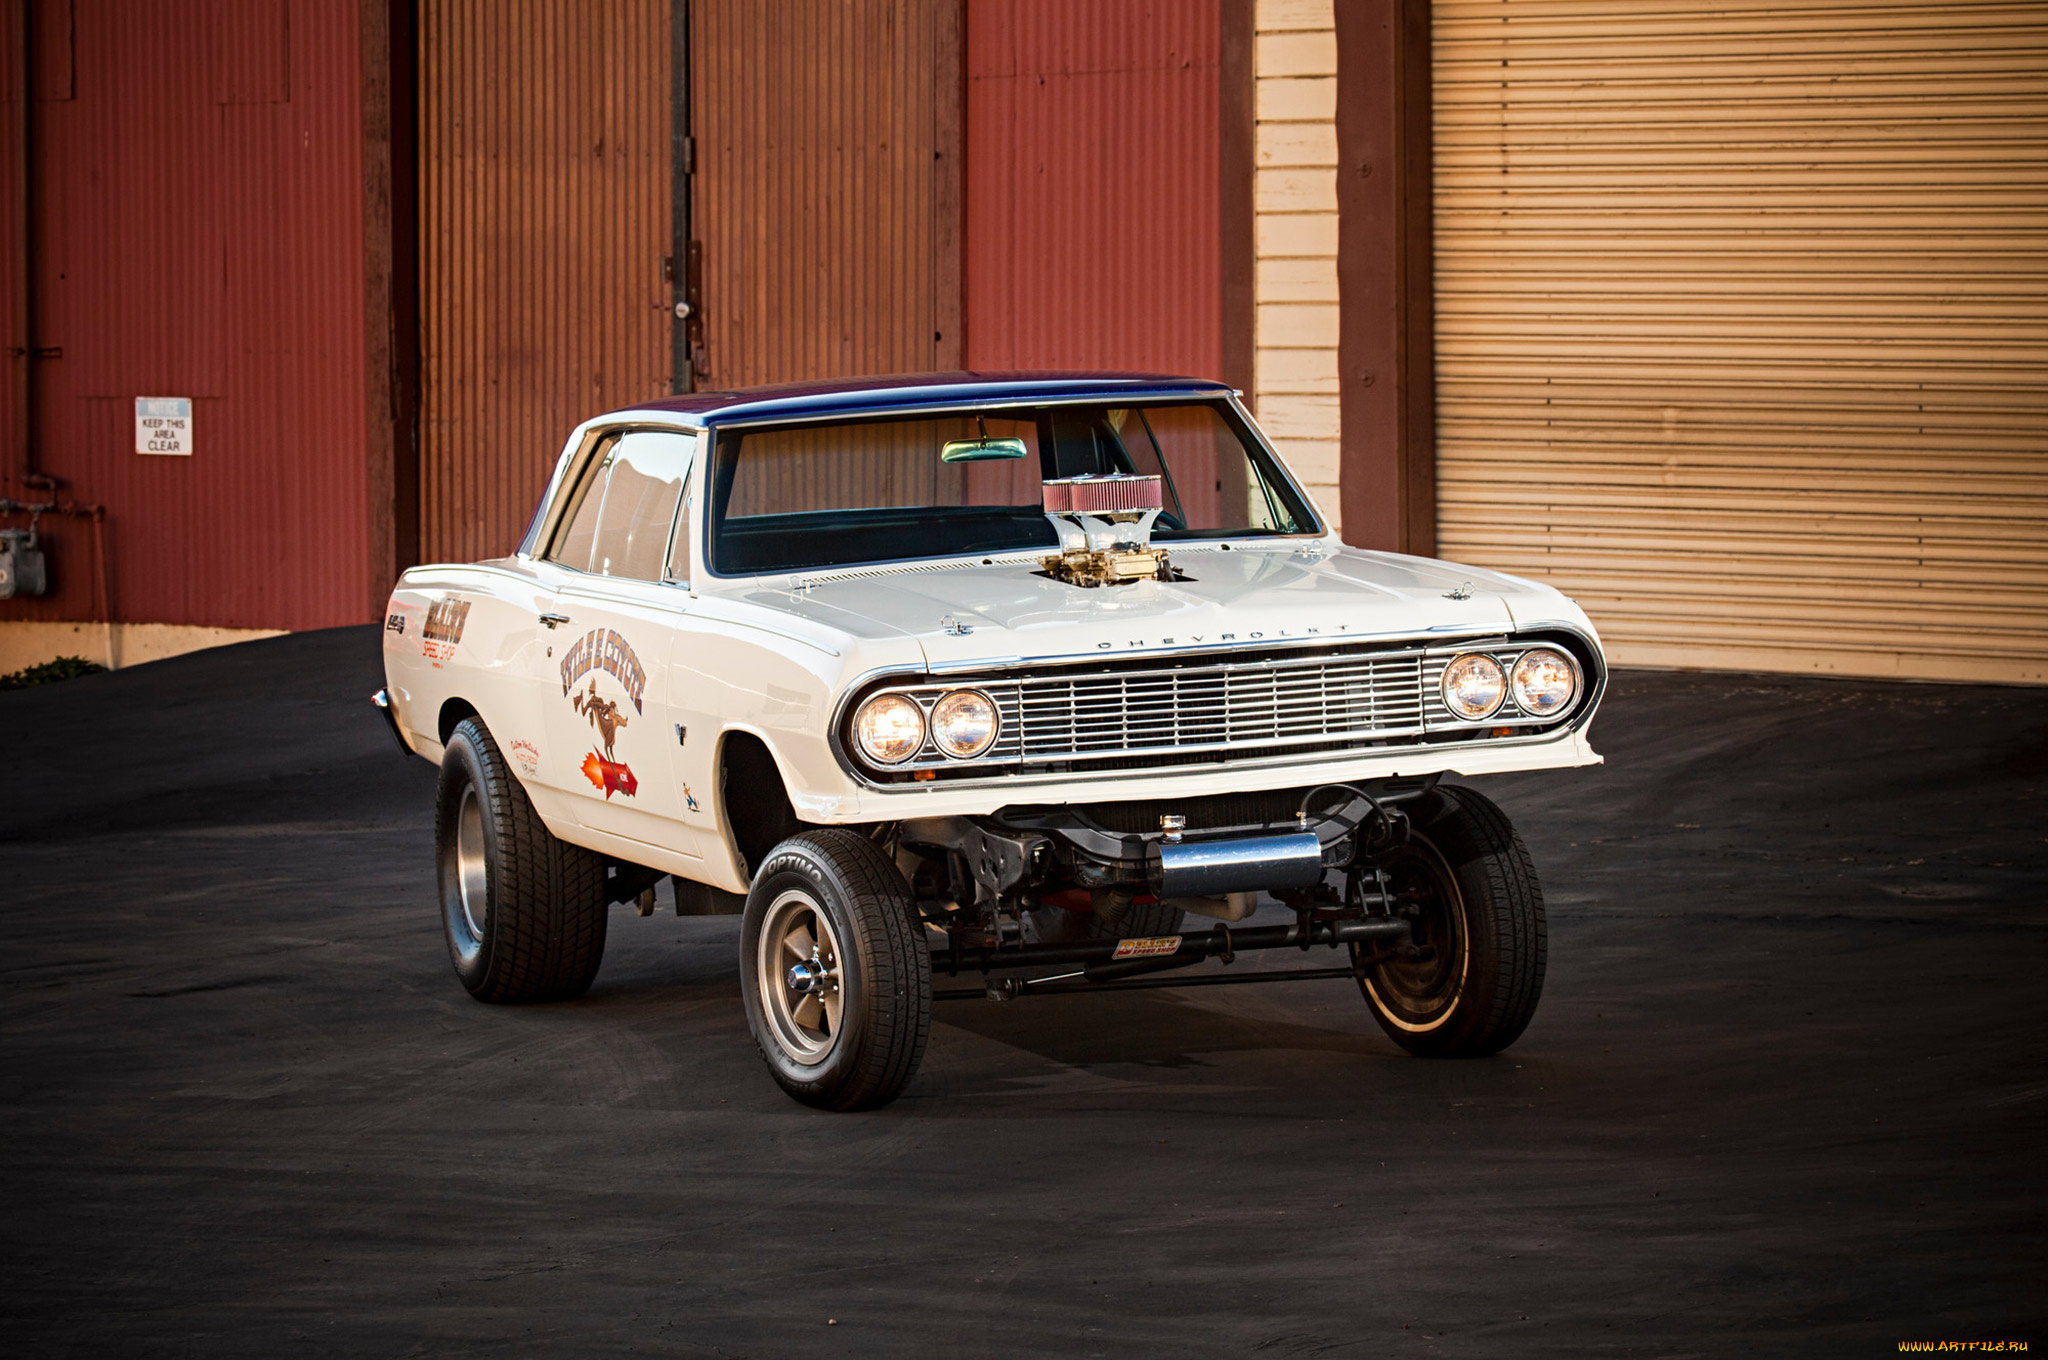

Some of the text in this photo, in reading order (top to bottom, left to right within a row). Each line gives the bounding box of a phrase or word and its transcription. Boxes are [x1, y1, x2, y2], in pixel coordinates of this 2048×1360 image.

[142, 419, 185, 429] KEEP THIS
[153, 430, 176, 439] AREA
[148, 440, 180, 451] CLEAR
[1098, 625, 1348, 649] CHEVROLET
[422, 641, 456, 661] SPEED SHOP
[560, 628, 646, 717] WILE E COYOTE
[767, 855, 822, 882] OPTIMO
